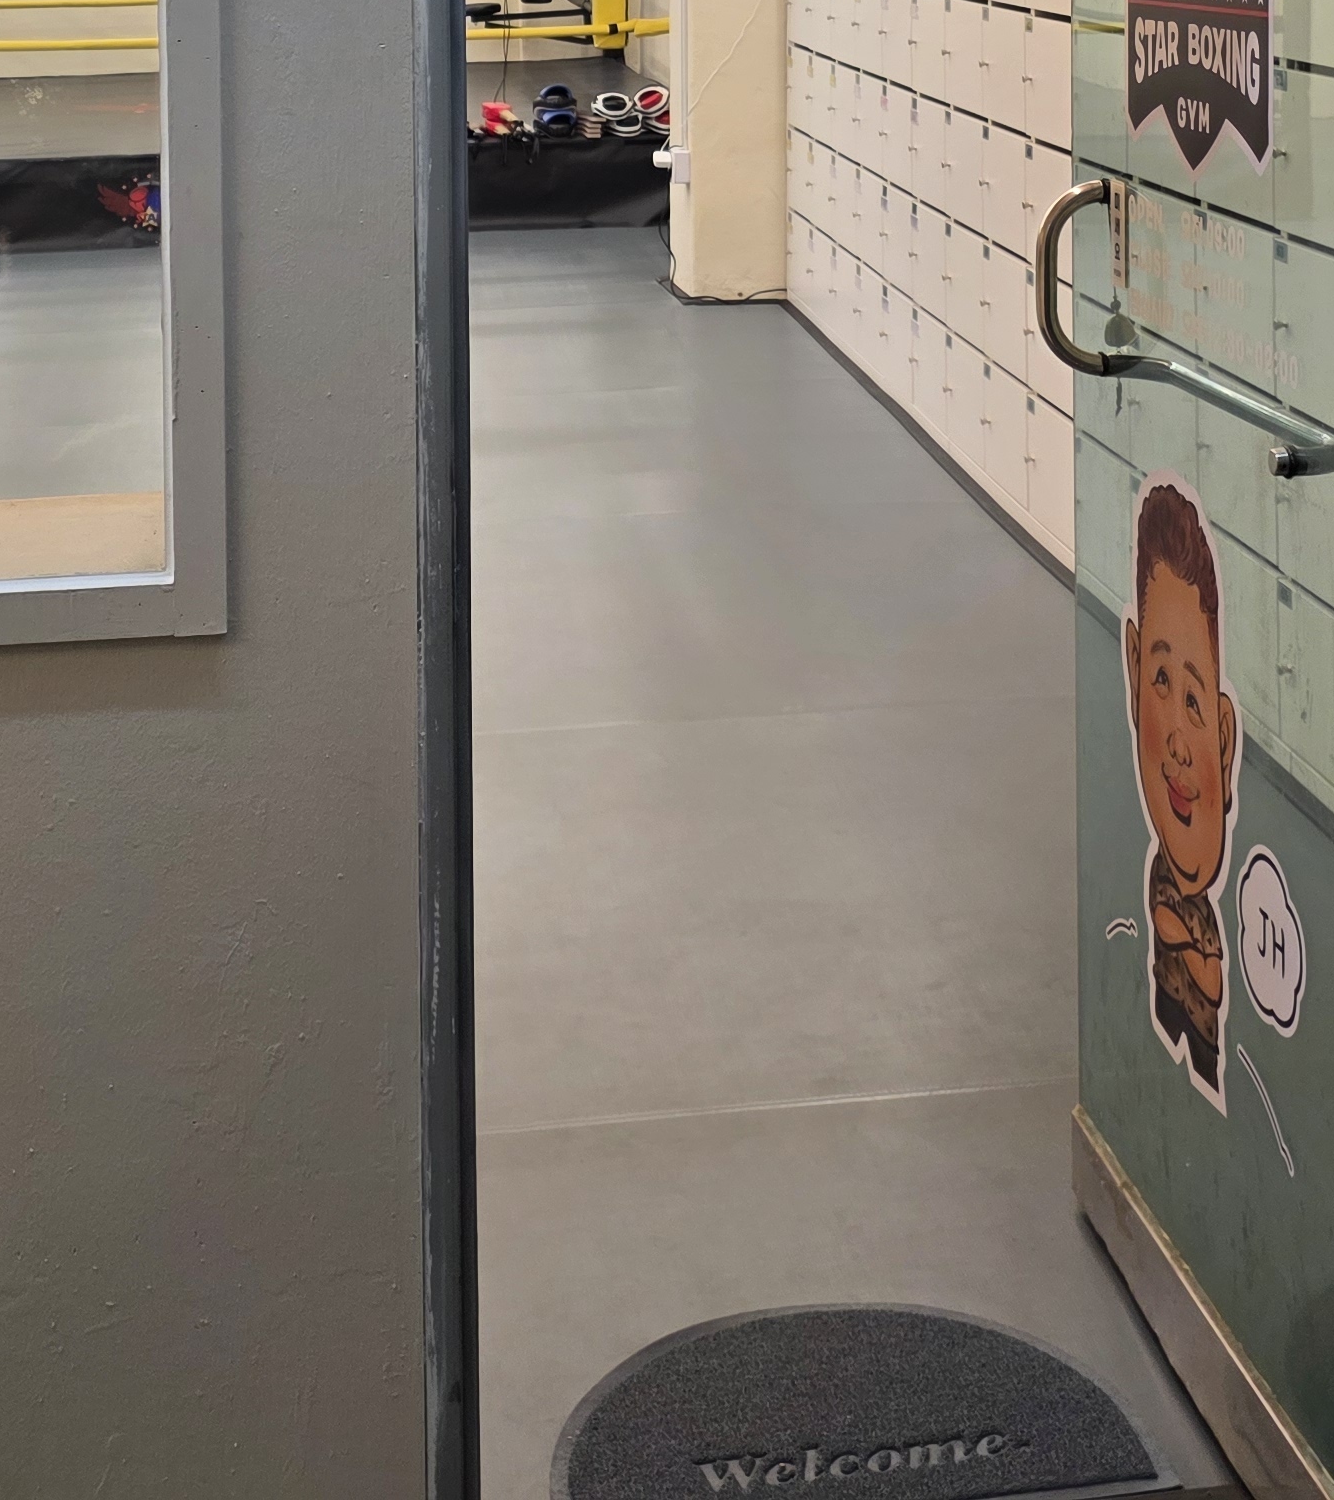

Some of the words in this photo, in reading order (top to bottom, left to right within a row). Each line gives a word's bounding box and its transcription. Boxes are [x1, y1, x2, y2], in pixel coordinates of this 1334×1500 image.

[1133, 17, 1179, 84] STAR
[1188, 23, 1260, 105] BOXING
[1177, 96, 1210, 134] GYM
[1257, 906, 1287, 980] JH
[693, 1431, 1023, 1491] Welcome
